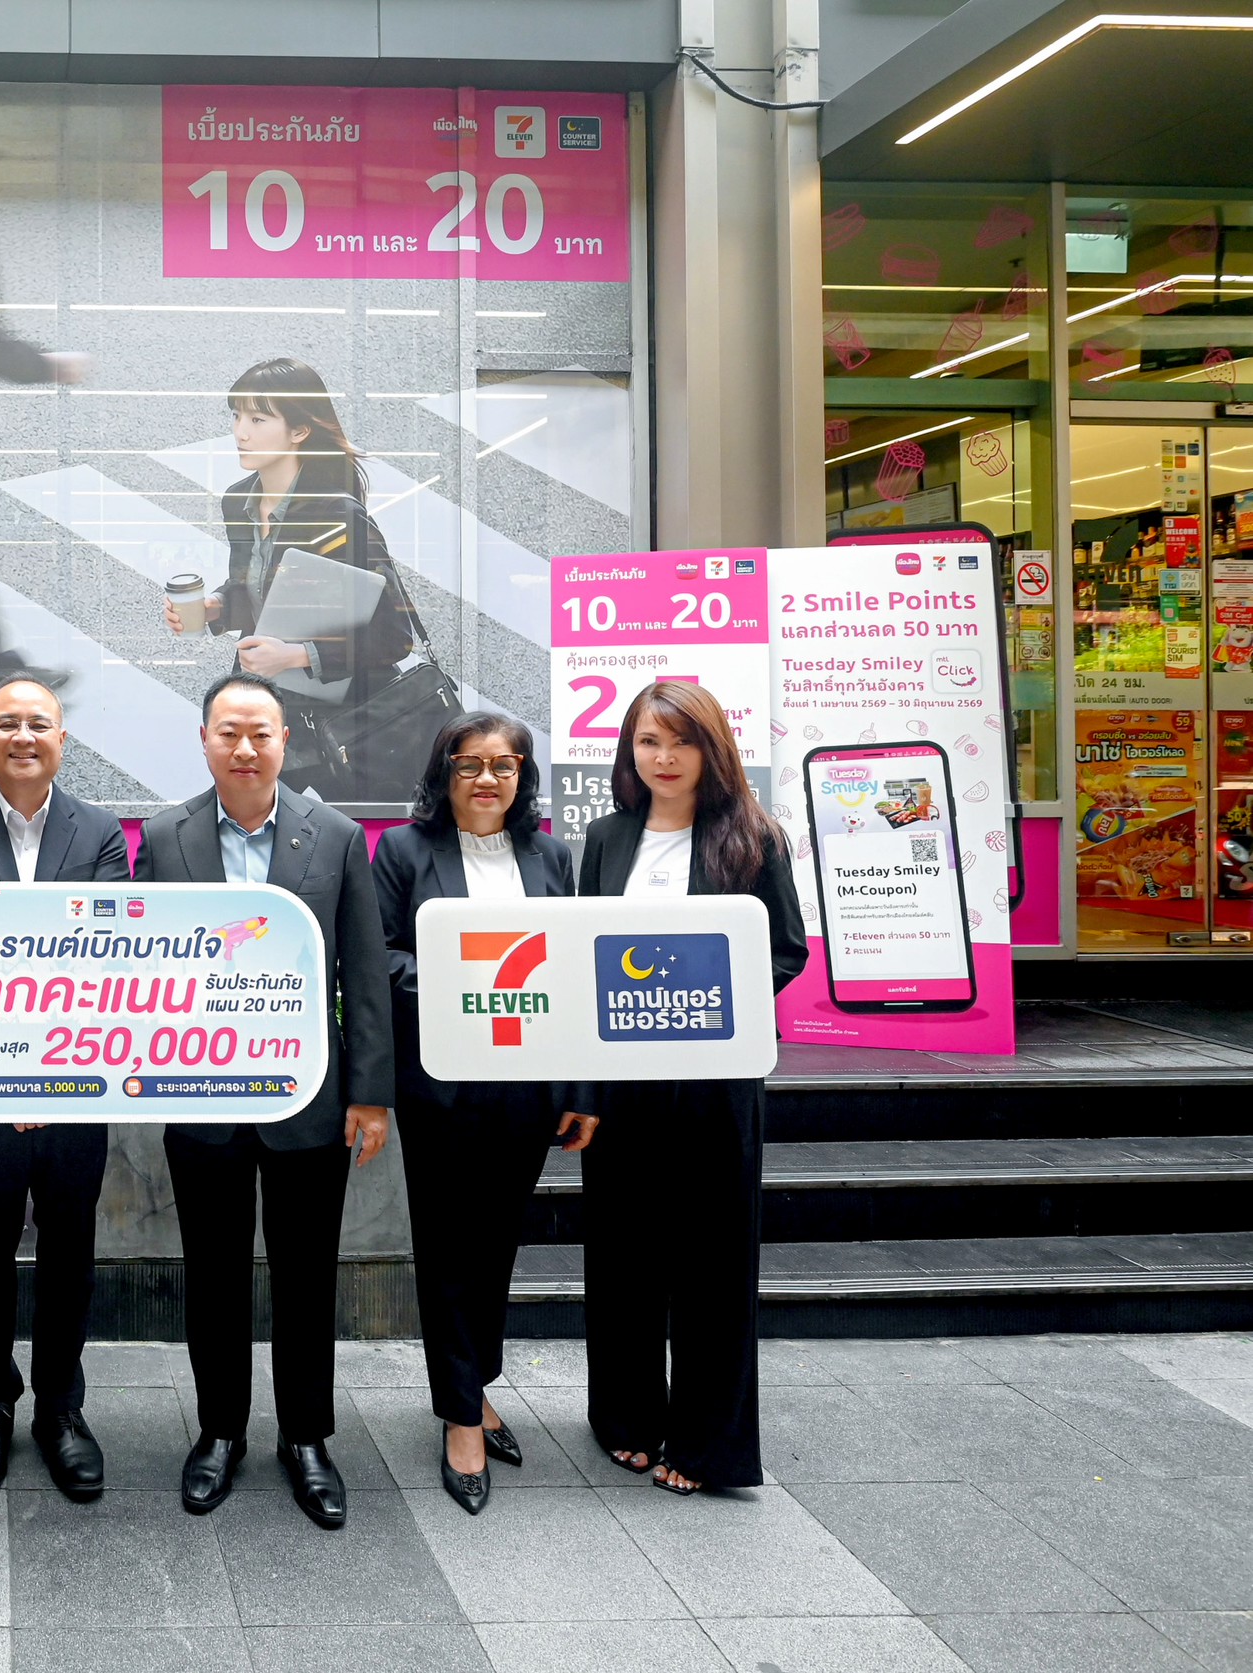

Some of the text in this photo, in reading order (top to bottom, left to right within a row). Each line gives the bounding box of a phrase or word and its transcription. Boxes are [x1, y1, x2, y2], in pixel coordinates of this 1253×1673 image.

[188, 106, 360, 142] เบี้ยประกันภัย
[187, 170, 603, 256] 10 บาท และ 20 บาท
[565, 566, 647, 583] เบี้ยประกันภัย
[781, 589, 976, 613] 2 Smile Points
[561, 592, 758, 632] 10 บาท และ 20 บาท
[781, 620, 978, 639] แลกส่วนลด 50 บาท
[566, 652, 668, 671] คุ้มครองสูงสุด
[782, 656, 924, 673] Tuesday Smiley
[937, 664, 975, 676] Click
[782, 675, 924, 695] รับสิทธิ์ทุกวันอังคาร
[1101, 678, 1117, 688] 24
[782, 697, 983, 710] ตั้งแต่ 1 เมษายน 2569 30 มิถุนายน 2569
[829, 768, 868, 779] Tuesday
[821, 779, 878, 795] Smiley
[835, 864, 940, 878] Tuesday Smiley
[837, 882, 917, 898] (M-Coupon)
[843, 931, 951, 941] 7-Eleven ส่วนลด 50 บาท
[844, 947, 882, 955] 2 คะแนน
[205, 972, 303, 991] รับประกันภัย
[205, 997, 302, 1013] แผน 20 บาท
[607, 985, 722, 1010] เคาน์เตอร์
[609, 1007, 710, 1030] เซอร์วิส
[41, 1026, 239, 1074] 250,000
[247, 1036, 301, 1059] บาท
[44, 1081, 75, 1095] 5,000
[78, 1081, 100, 1094] บาท
[156, 1079, 280, 1096] ระยะเวลาคุ้มครอง 30 วัน
